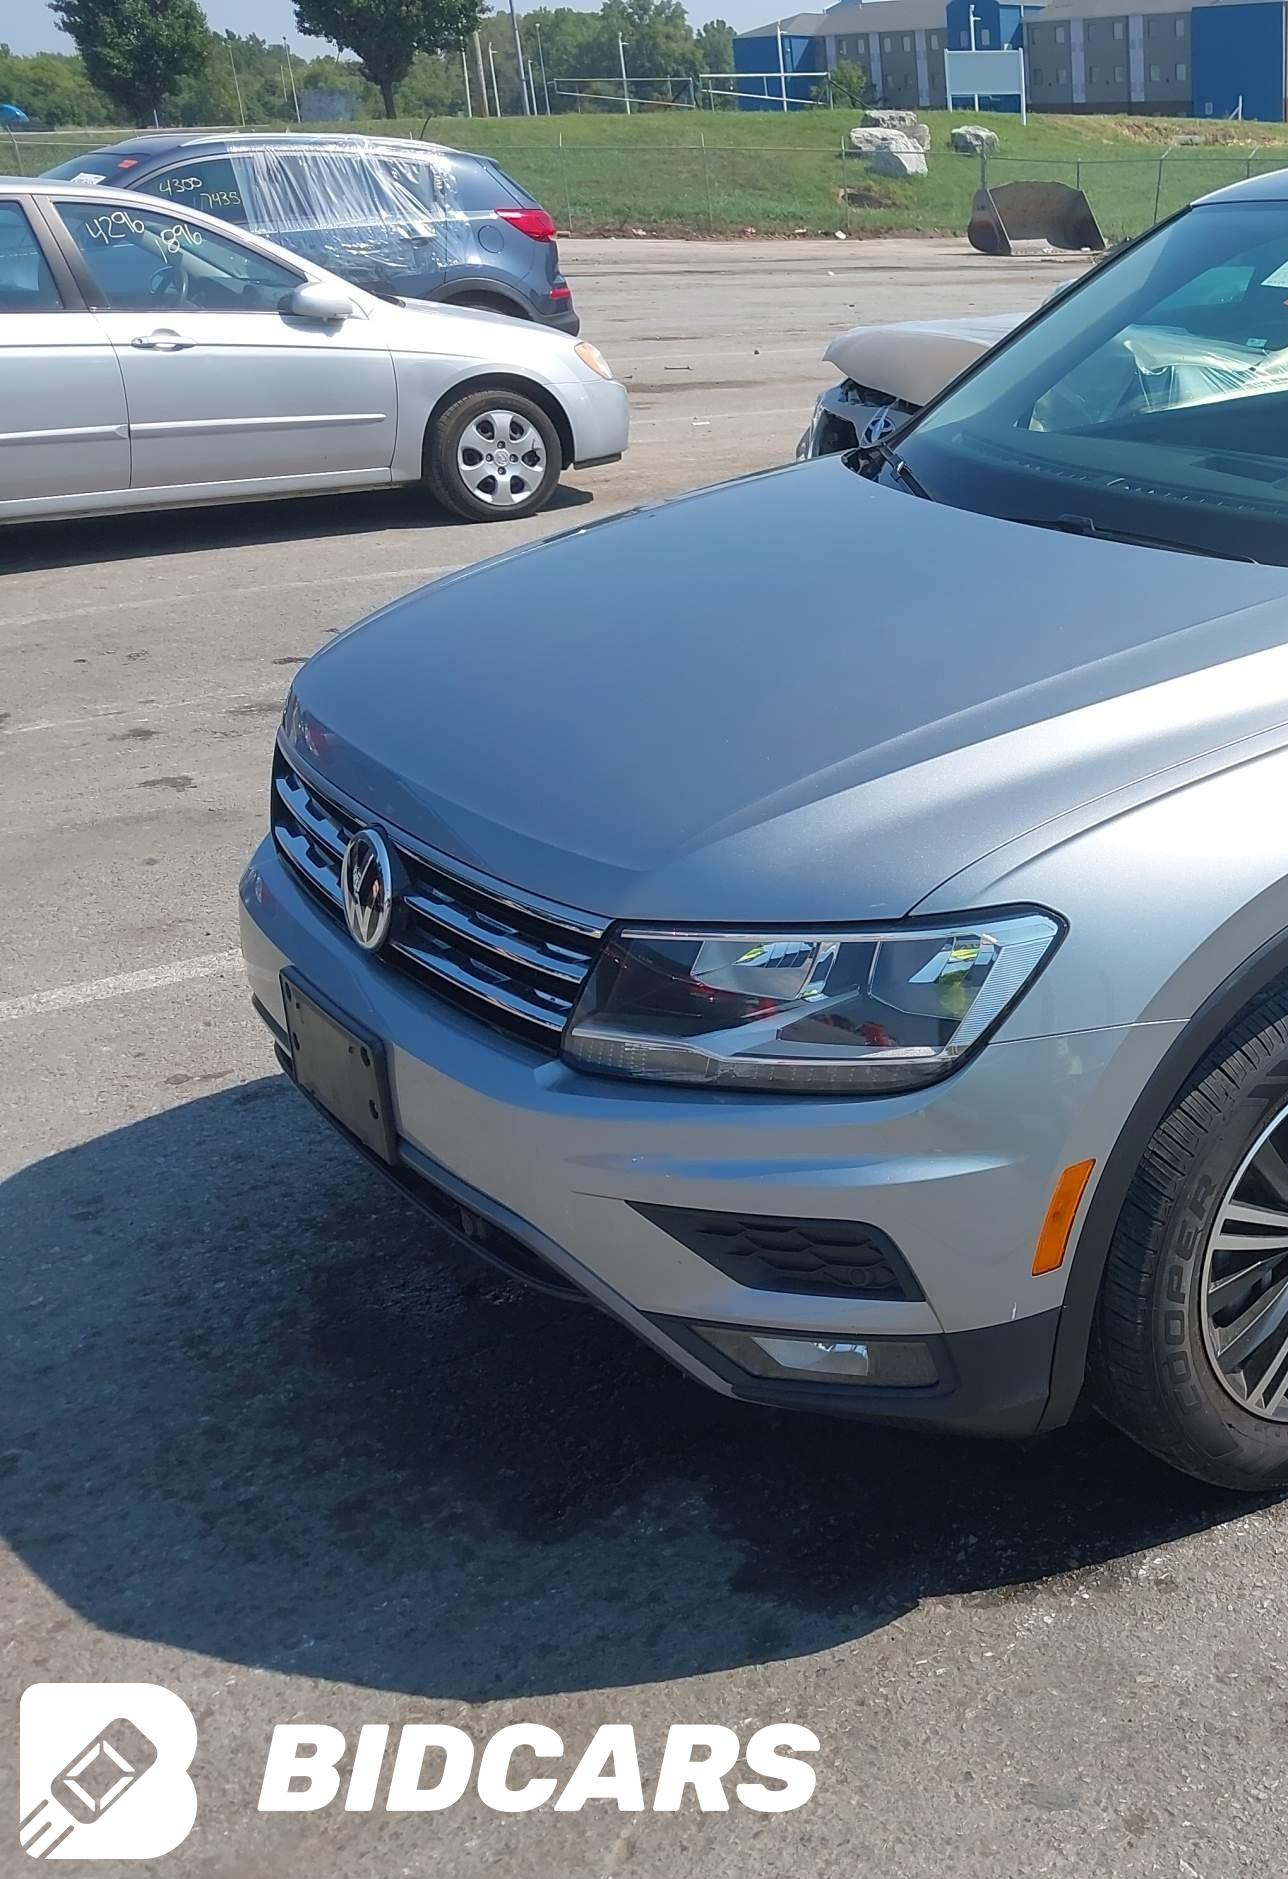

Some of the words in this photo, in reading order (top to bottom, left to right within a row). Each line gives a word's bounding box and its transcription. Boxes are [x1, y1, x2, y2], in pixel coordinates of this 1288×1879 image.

[159, 176, 202, 196] 4300
[199, 191, 241, 208] 7435
[85, 211, 145, 244] 4296
[154, 223, 203, 264] 1896
[1165, 1174, 1217, 1414] COOPER
